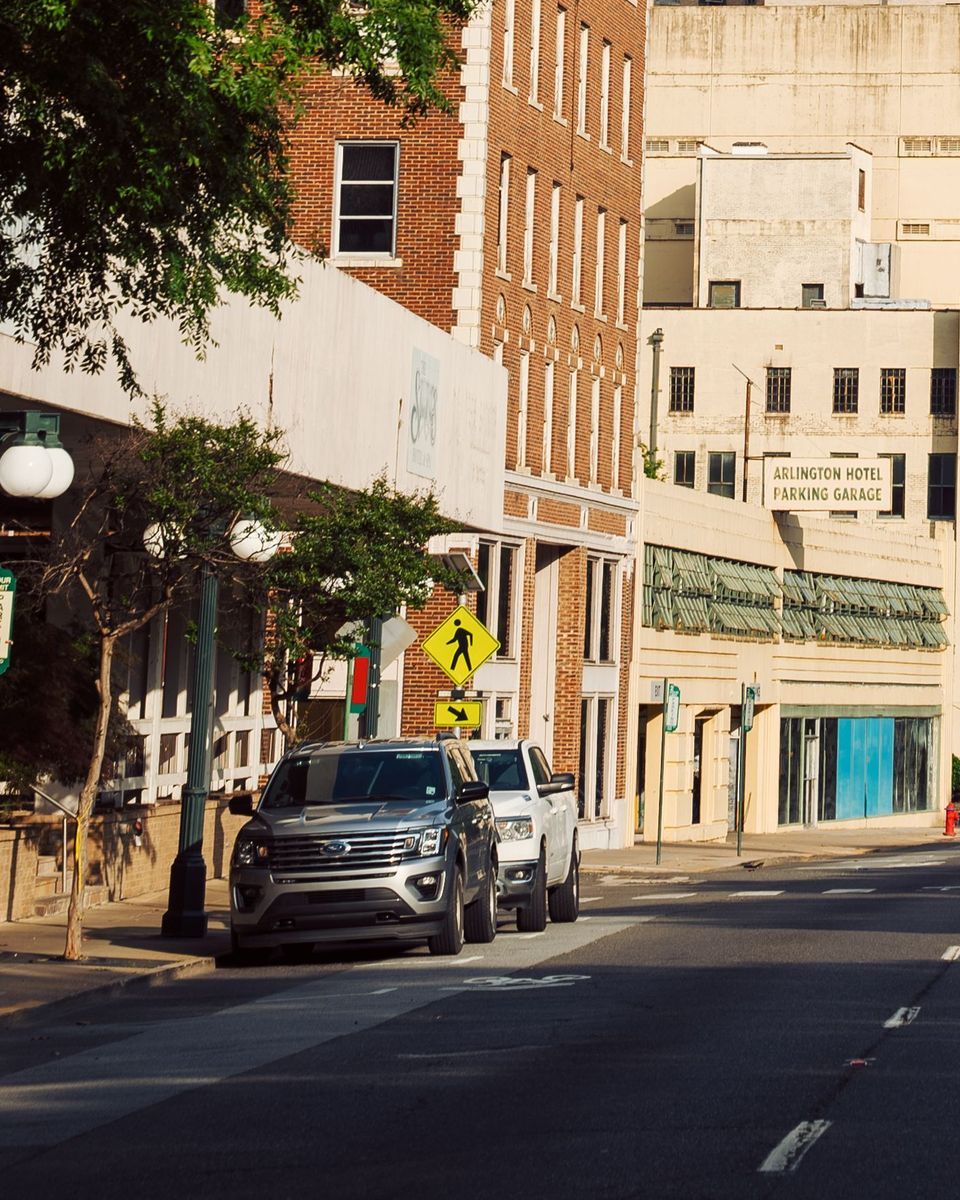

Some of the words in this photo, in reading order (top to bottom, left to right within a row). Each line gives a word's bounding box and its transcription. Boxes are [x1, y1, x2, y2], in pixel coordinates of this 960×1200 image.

[773, 466, 841, 481] ARLINGTON
[846, 467, 883, 481] HOTEL
[773, 487, 829, 501] PARKING
[833, 487, 882, 501] GARAGE
